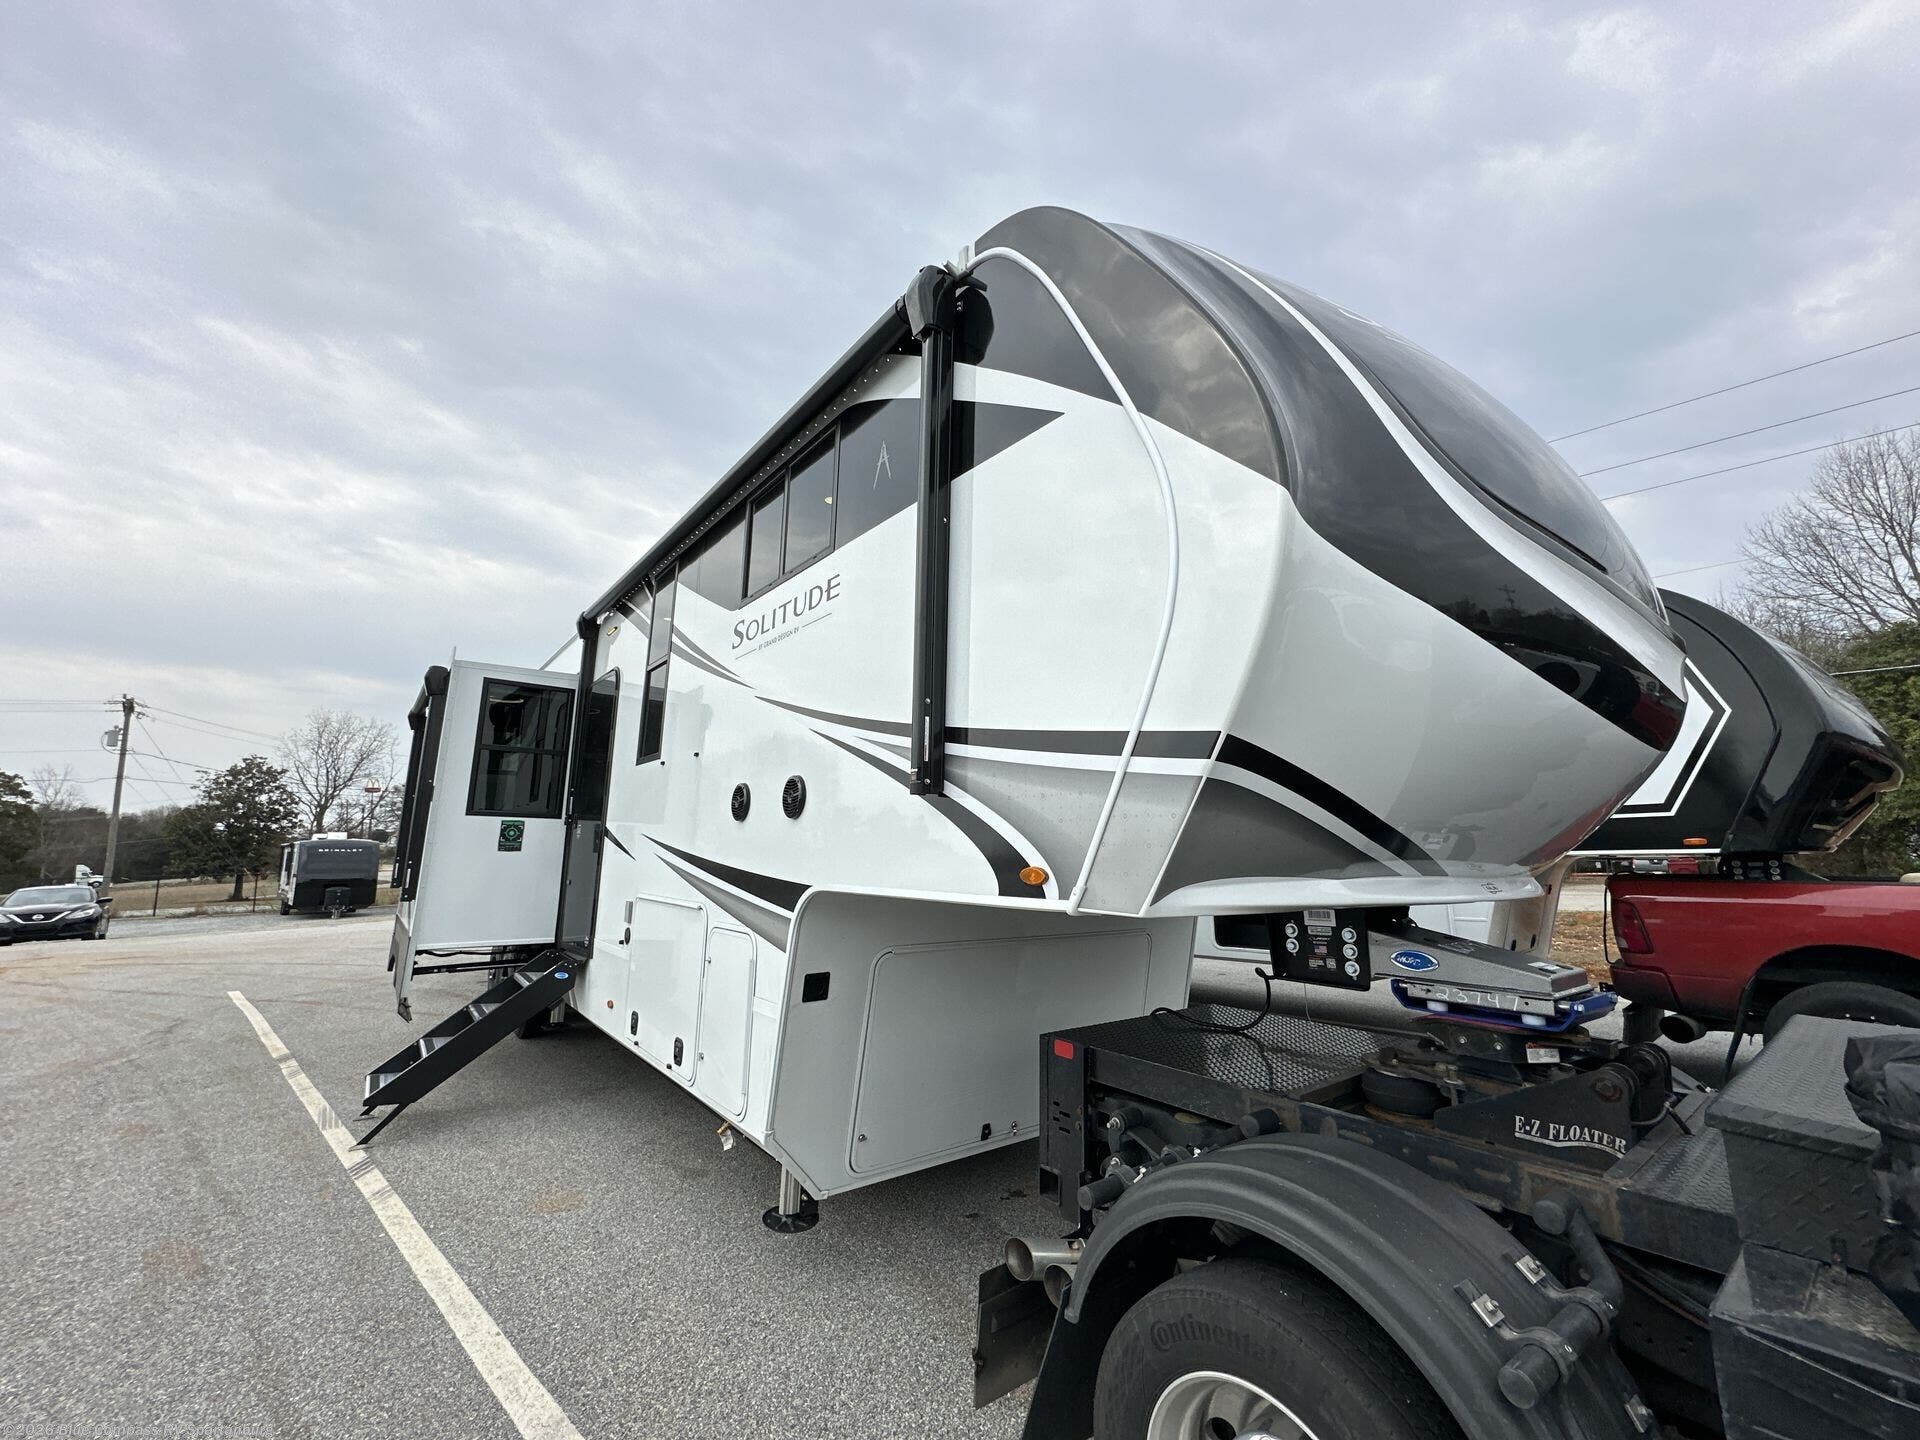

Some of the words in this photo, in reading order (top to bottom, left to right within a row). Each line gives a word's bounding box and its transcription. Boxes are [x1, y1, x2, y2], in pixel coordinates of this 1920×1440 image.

[732, 573, 841, 650] SOLITUDE
[777, 630, 793, 643] DESIGN
[1436, 987, 1519, 1011] 23747
[1515, 1115, 1540, 1137] E-Z
[1548, 1123, 1627, 1154] FLOATER
